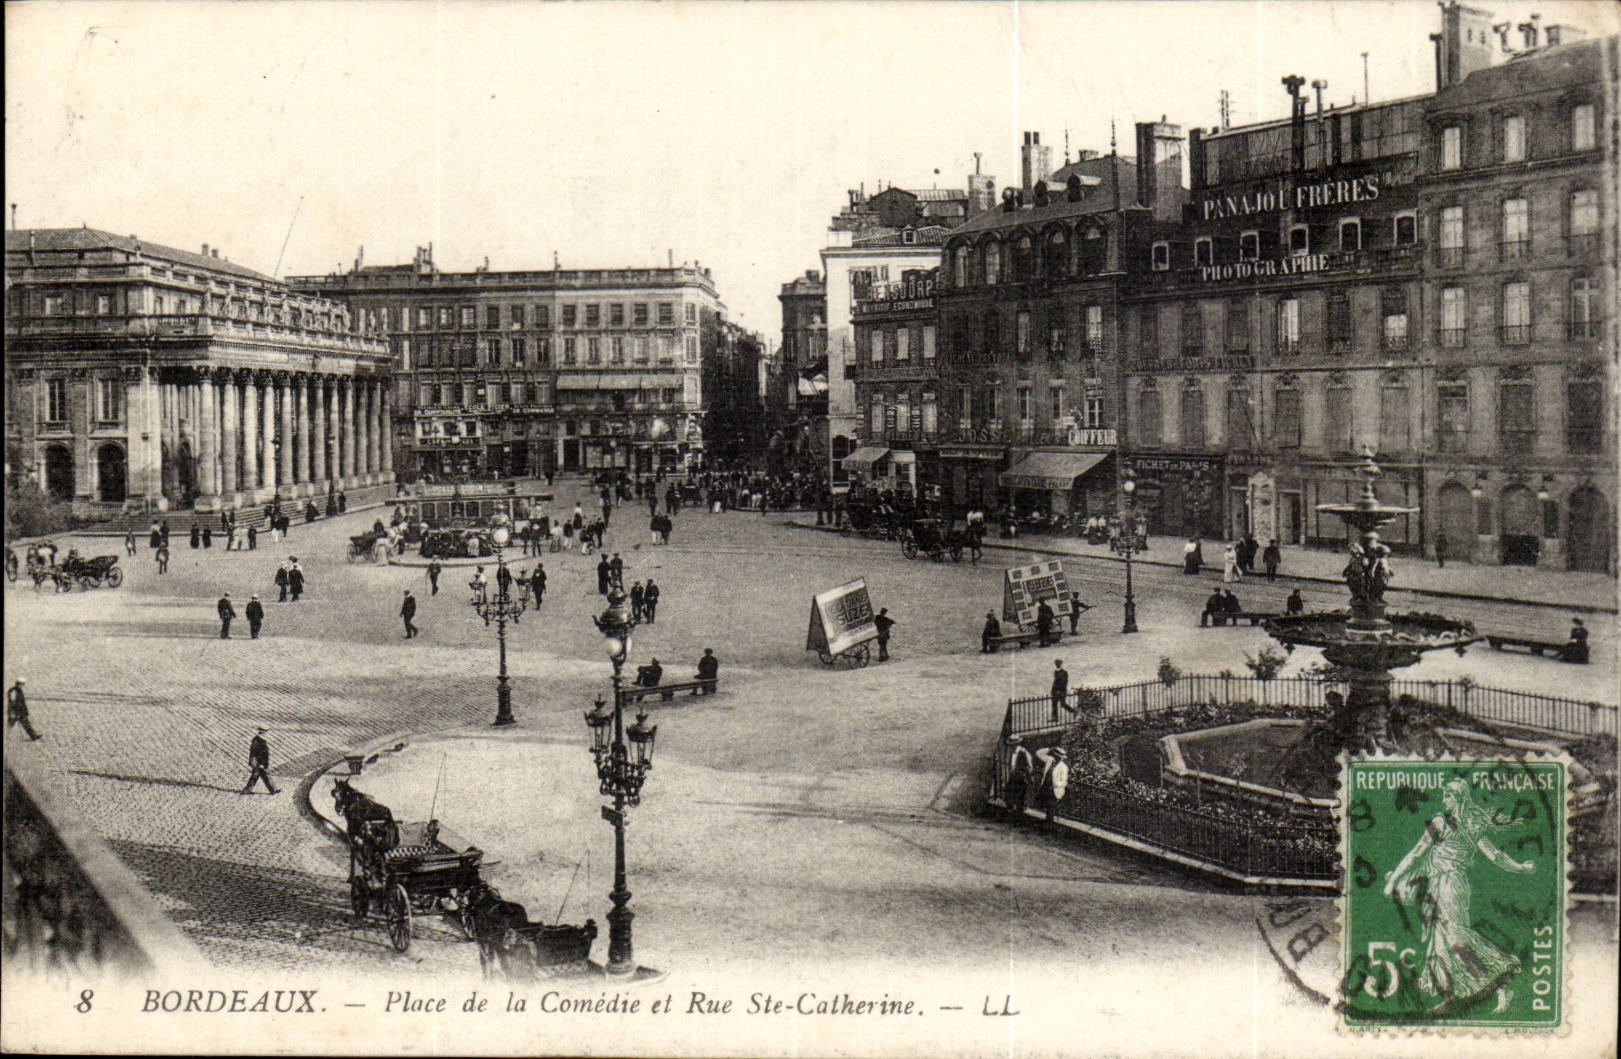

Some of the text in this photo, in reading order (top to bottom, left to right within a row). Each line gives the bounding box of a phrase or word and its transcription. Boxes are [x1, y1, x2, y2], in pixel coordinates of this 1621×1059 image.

[1204, 187, 1288, 220] PANAJOU
[1203, 254, 1330, 281] PHOTOGRAPHIE
[1068, 429, 1117, 446] COIFFEUR
[836, 605, 871, 628] SUZE
[1356, 771, 1555, 793] REPUBLIQUE FRANÇAISE
[1532, 924, 1553, 1011] POSTES
